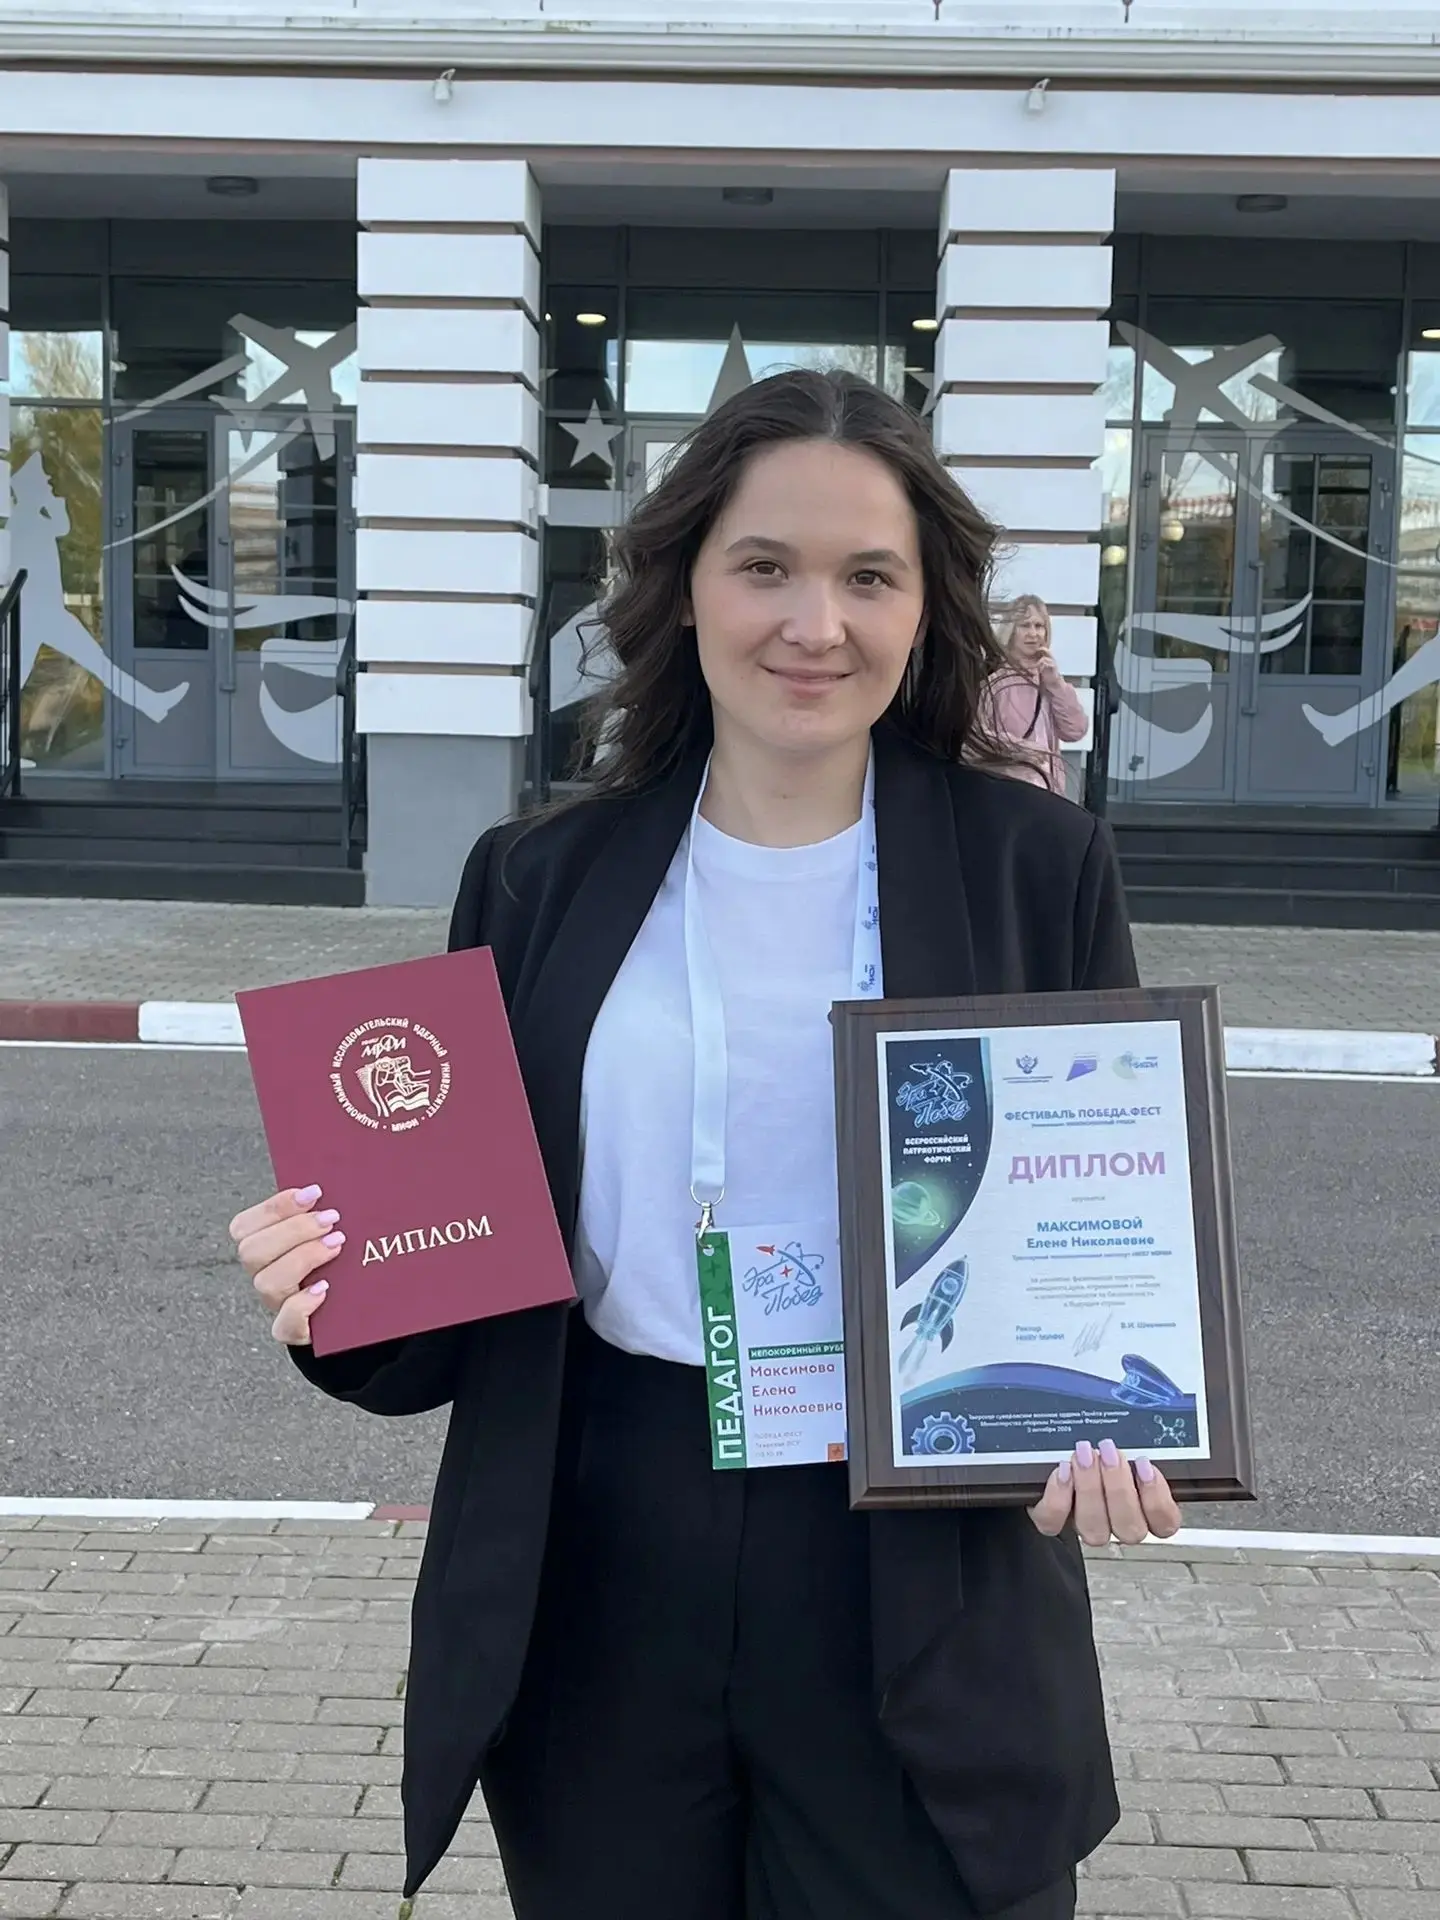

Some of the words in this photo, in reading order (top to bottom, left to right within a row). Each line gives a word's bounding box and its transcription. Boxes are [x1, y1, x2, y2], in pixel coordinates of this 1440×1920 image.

[331, 1017, 409, 1068] ИССЛЕДОВАТЕЛЬСКИЙ
[412, 1024, 449, 1058] ЯДЕРНЫЙ
[425, 1061, 451, 1119] УНИВЕРСИТЕТ
[1004, 1109, 1076, 1121] ФЕСТИВАЛЬ
[1078, 1106, 1162, 1119] ПОБЕДА.ФЕСТ
[904, 1134, 969, 1146] ВСЕРОССИЙСКИЙ
[903, 1144, 972, 1156] ПАТРИОТИЧЕСКИЙ
[923, 1155, 952, 1164] ФОРУМ
[1008, 1151, 1166, 1184] ДИПЛОМ
[1036, 1216, 1144, 1233] МАКСИМОВОЙ
[361, 1215, 494, 1267] ДИПЛОМ
[1027, 1238, 1068, 1250] Елене
[1071, 1235, 1155, 1248] Николаевне
[750, 1345, 822, 1358] НЕПОКОРЕННЫЙ
[750, 1362, 836, 1378] Максимова
[707, 1306, 744, 1459] ПЕДАГОГ
[752, 1385, 797, 1398] Елена
[753, 1401, 843, 1417] Николаевна
